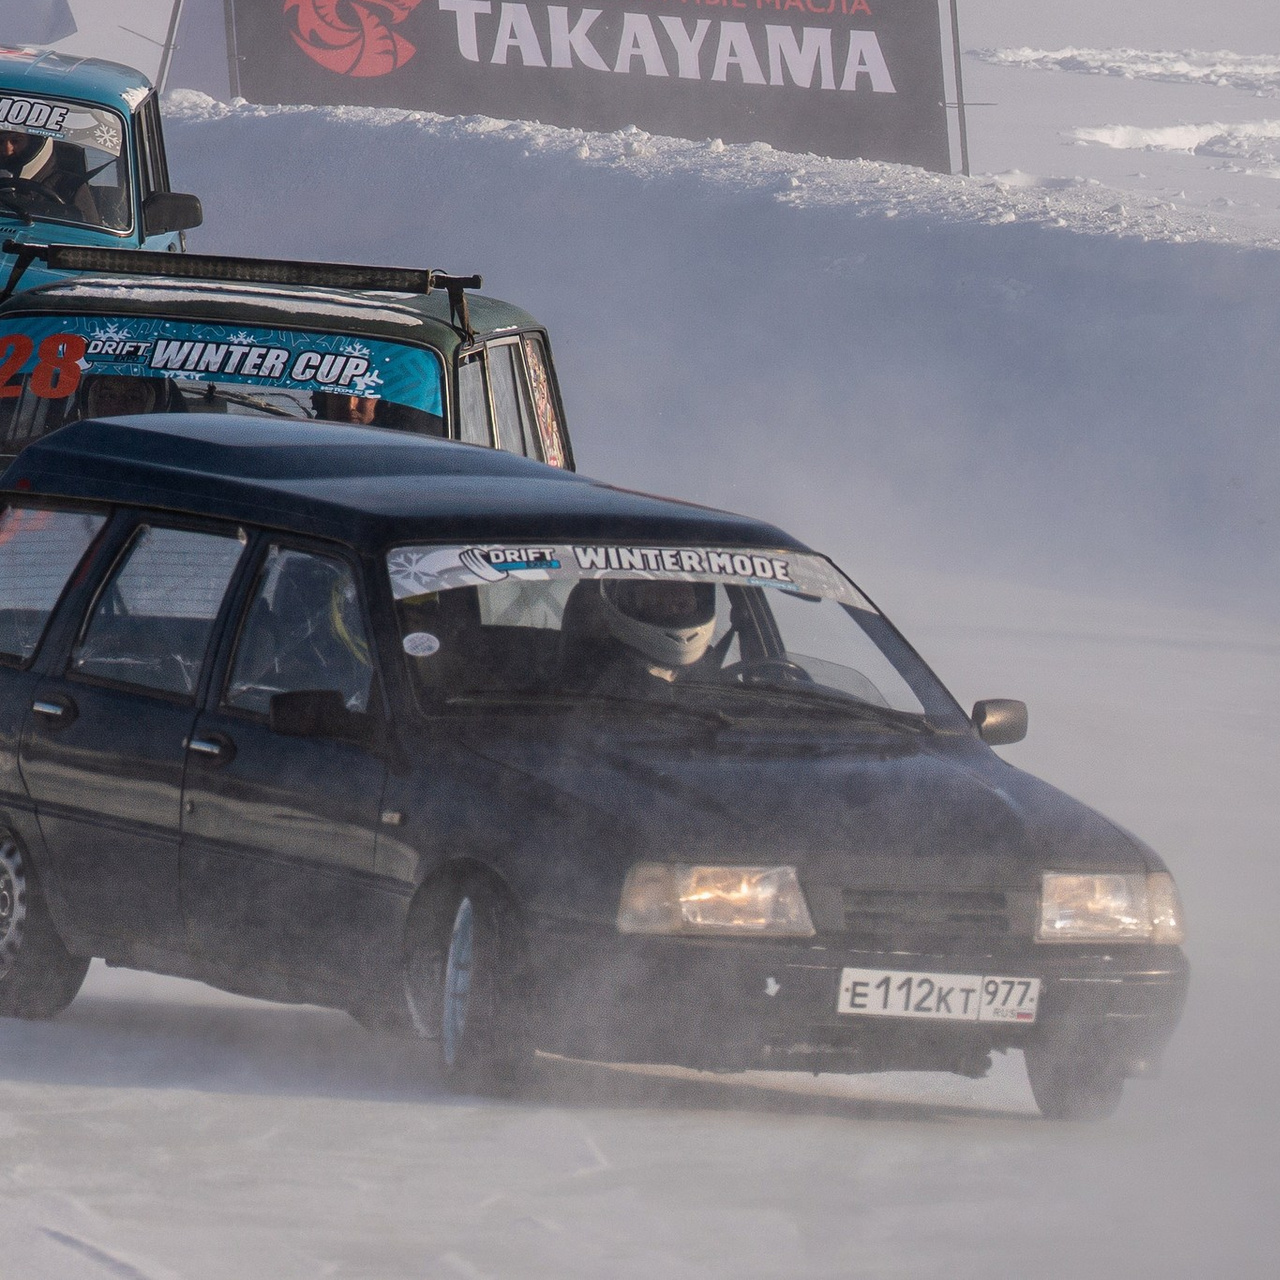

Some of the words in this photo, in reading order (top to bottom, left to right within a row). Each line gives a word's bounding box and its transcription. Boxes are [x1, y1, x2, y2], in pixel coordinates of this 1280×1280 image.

[87, 340, 151, 356] DRIFT
[149, 338, 288, 382] WINTER
[291, 351, 369, 386] CUP
[489, 548, 555, 564] DRIFT
[574, 546, 709, 575] WINTER
[707, 550, 793, 582] MODE
[984, 979, 1032, 1007] 977
[993, 1008, 1016, 1019] RUS
